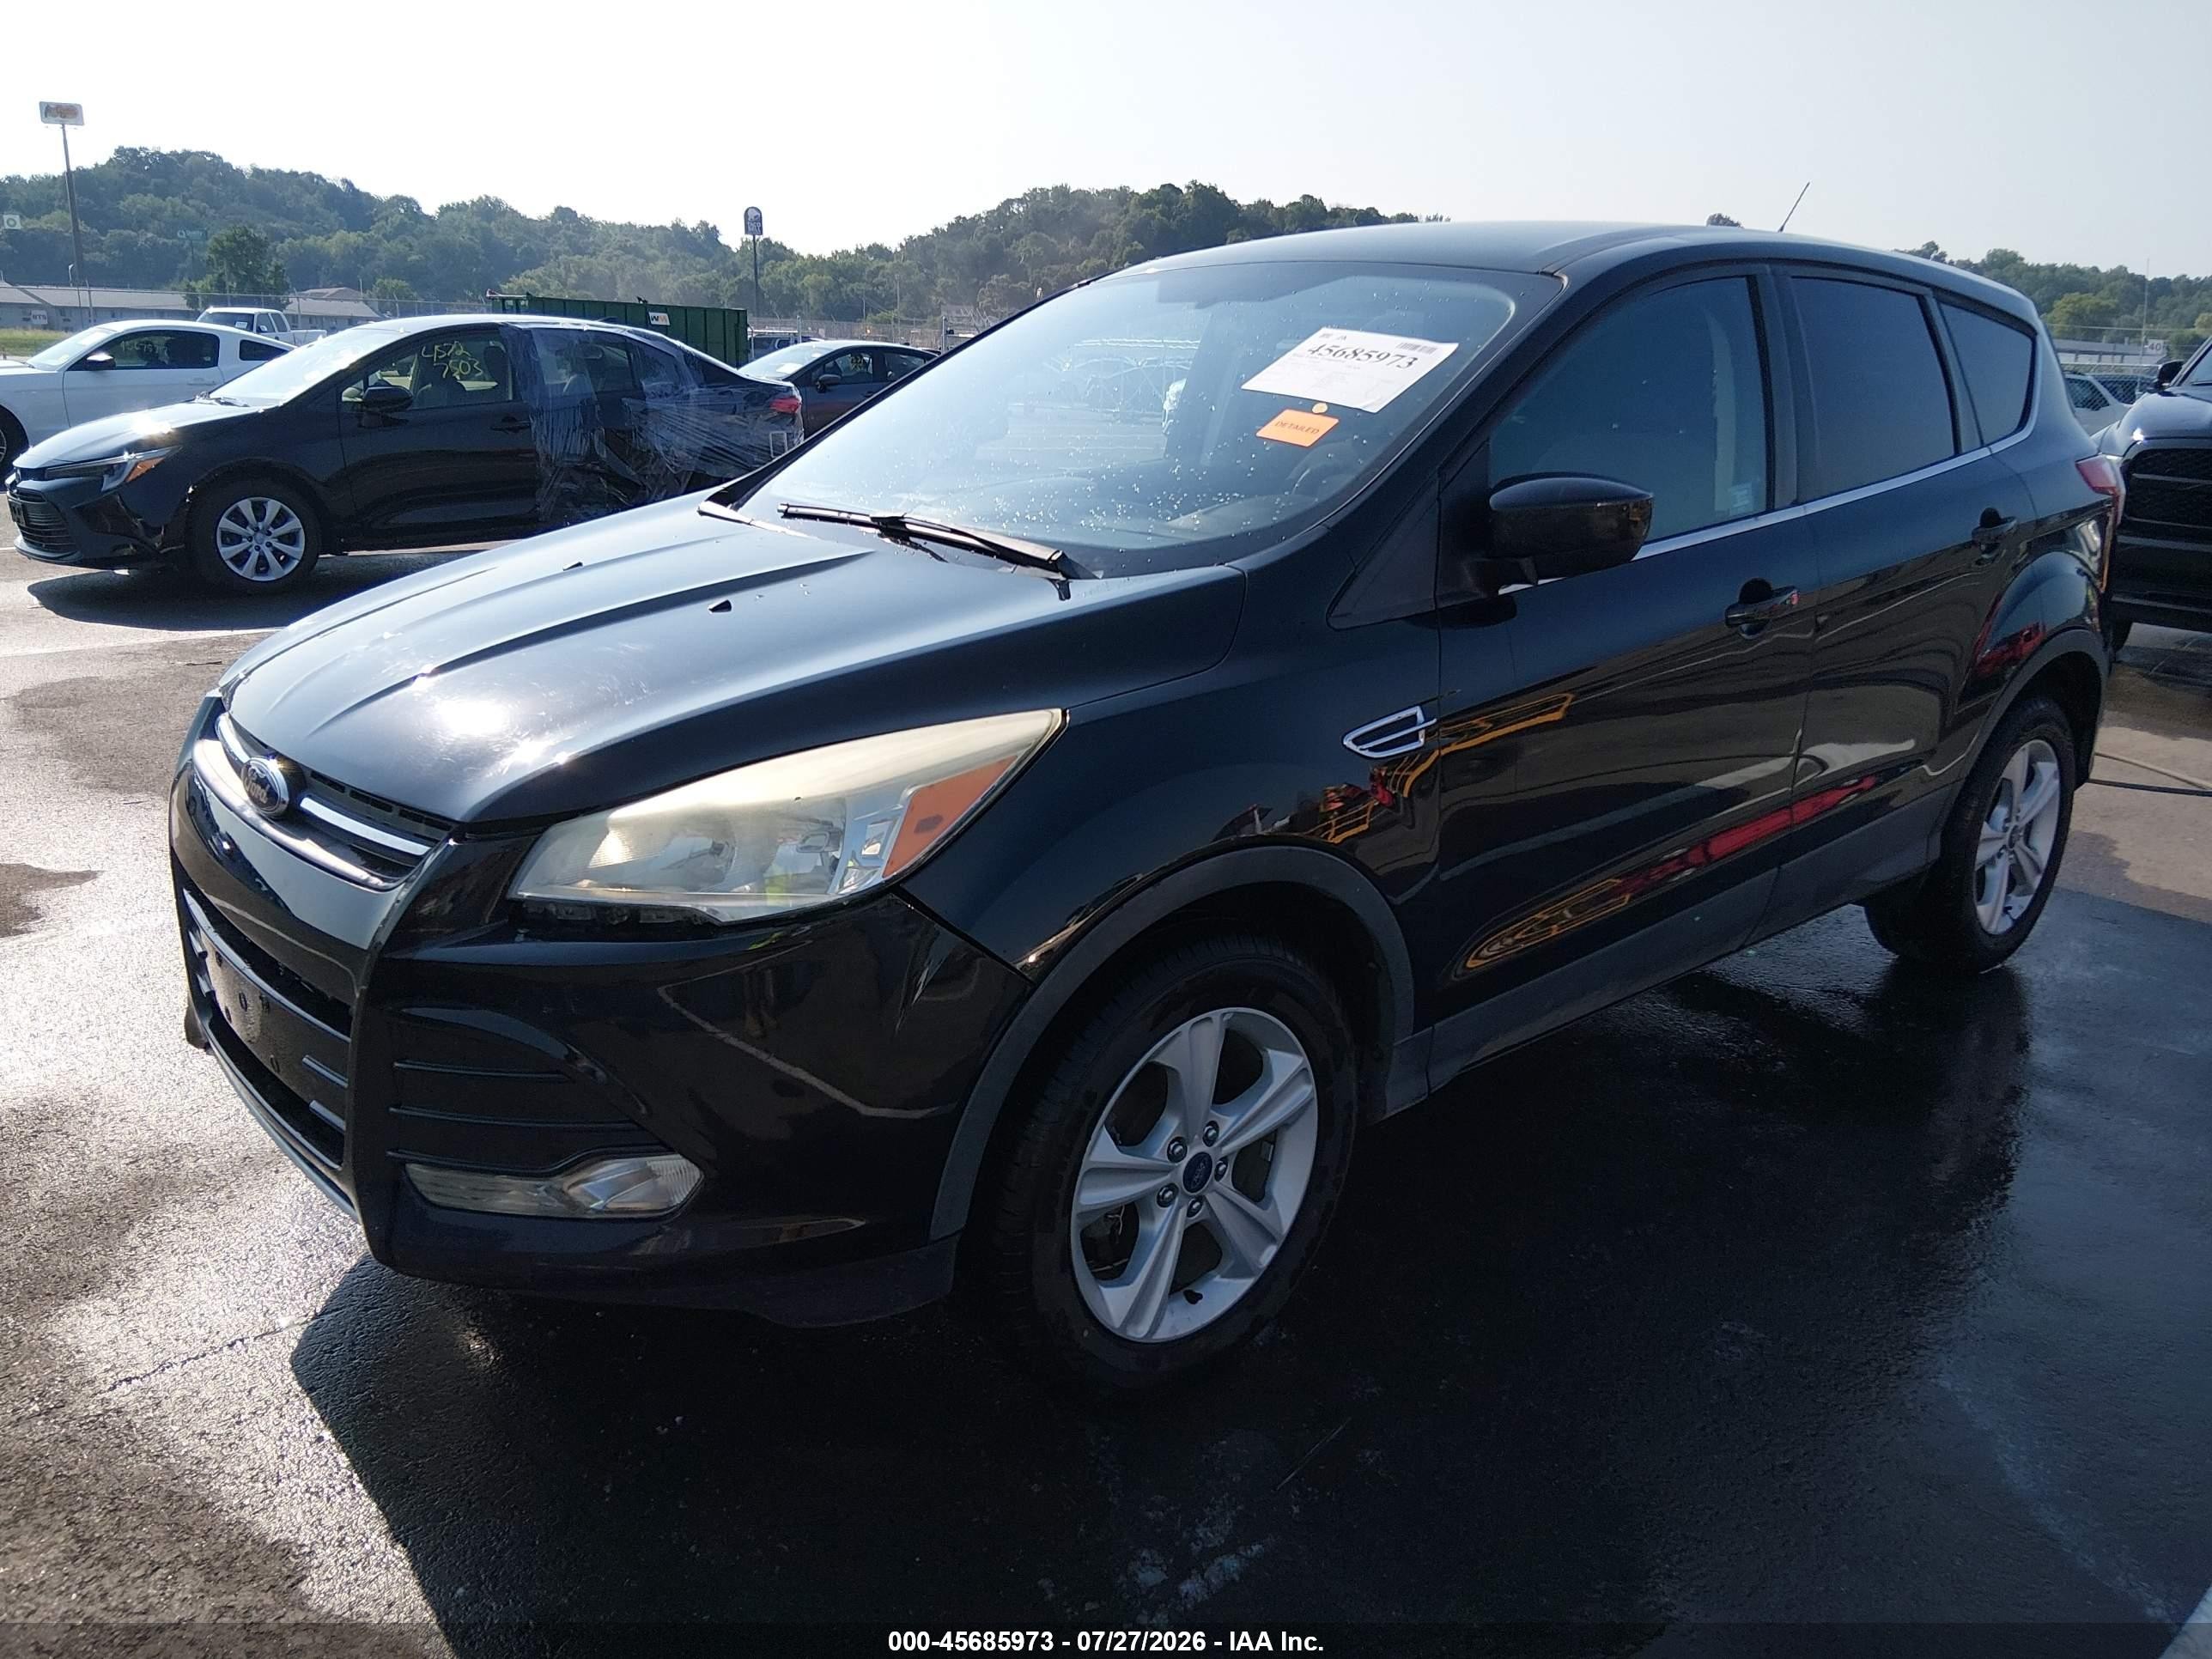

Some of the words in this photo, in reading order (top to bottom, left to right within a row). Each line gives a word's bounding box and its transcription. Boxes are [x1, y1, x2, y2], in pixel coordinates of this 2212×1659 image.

[1308, 343, 1419, 369] 45685973
[1274, 421, 1320, 434] DETAILED
[244, 764, 271, 804] Ford
